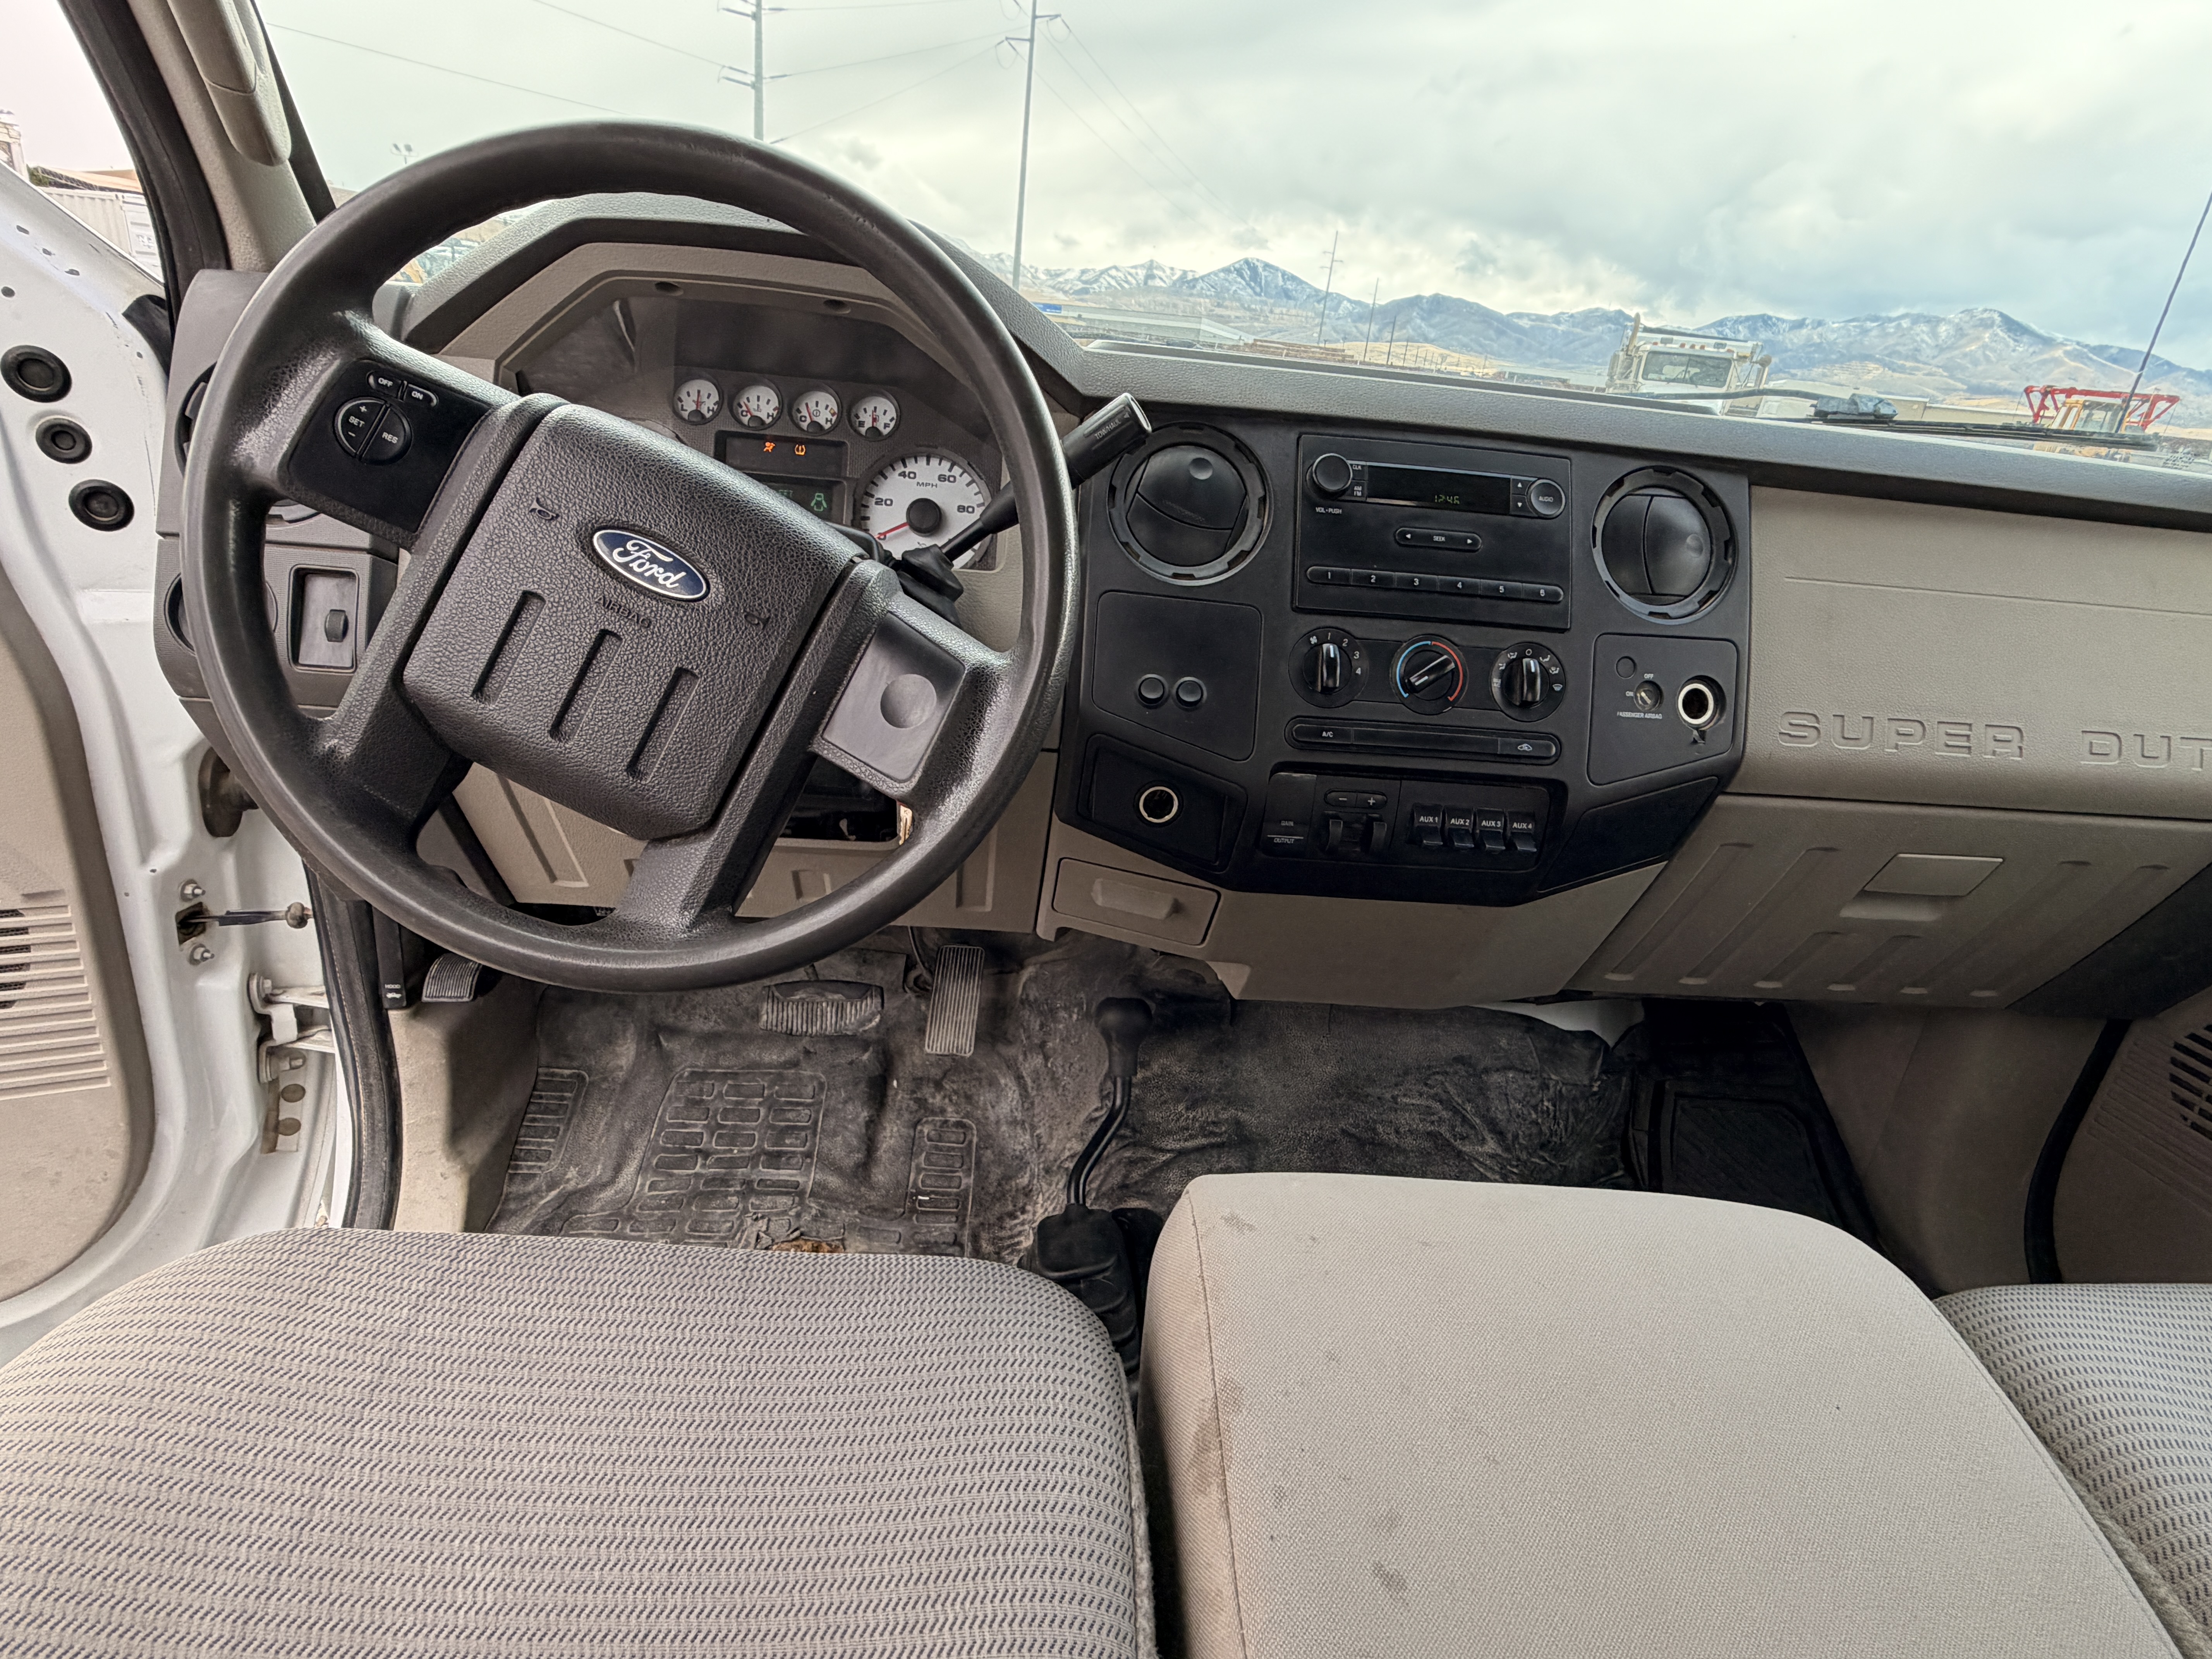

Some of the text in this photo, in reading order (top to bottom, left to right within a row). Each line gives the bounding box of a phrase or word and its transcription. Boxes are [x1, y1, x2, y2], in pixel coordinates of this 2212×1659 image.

[378, 378, 393, 387] OFF
[411, 391, 423, 400] ON
[349, 416, 365, 428] SET
[382, 432, 398, 443] RES
[898, 471, 917, 479] 40
[938, 474, 957, 483] 60
[874, 497, 893, 507] 20
[957, 505, 975, 514] 80
[613, 540, 687, 588] Ford
[595, 596, 651, 628] AIRBAG
[1328, 632, 1331, 641] 1
[1342, 638, 1348, 647] 2
[1353, 651, 1360, 659] 3
[1778, 711, 2025, 760] SUPER
